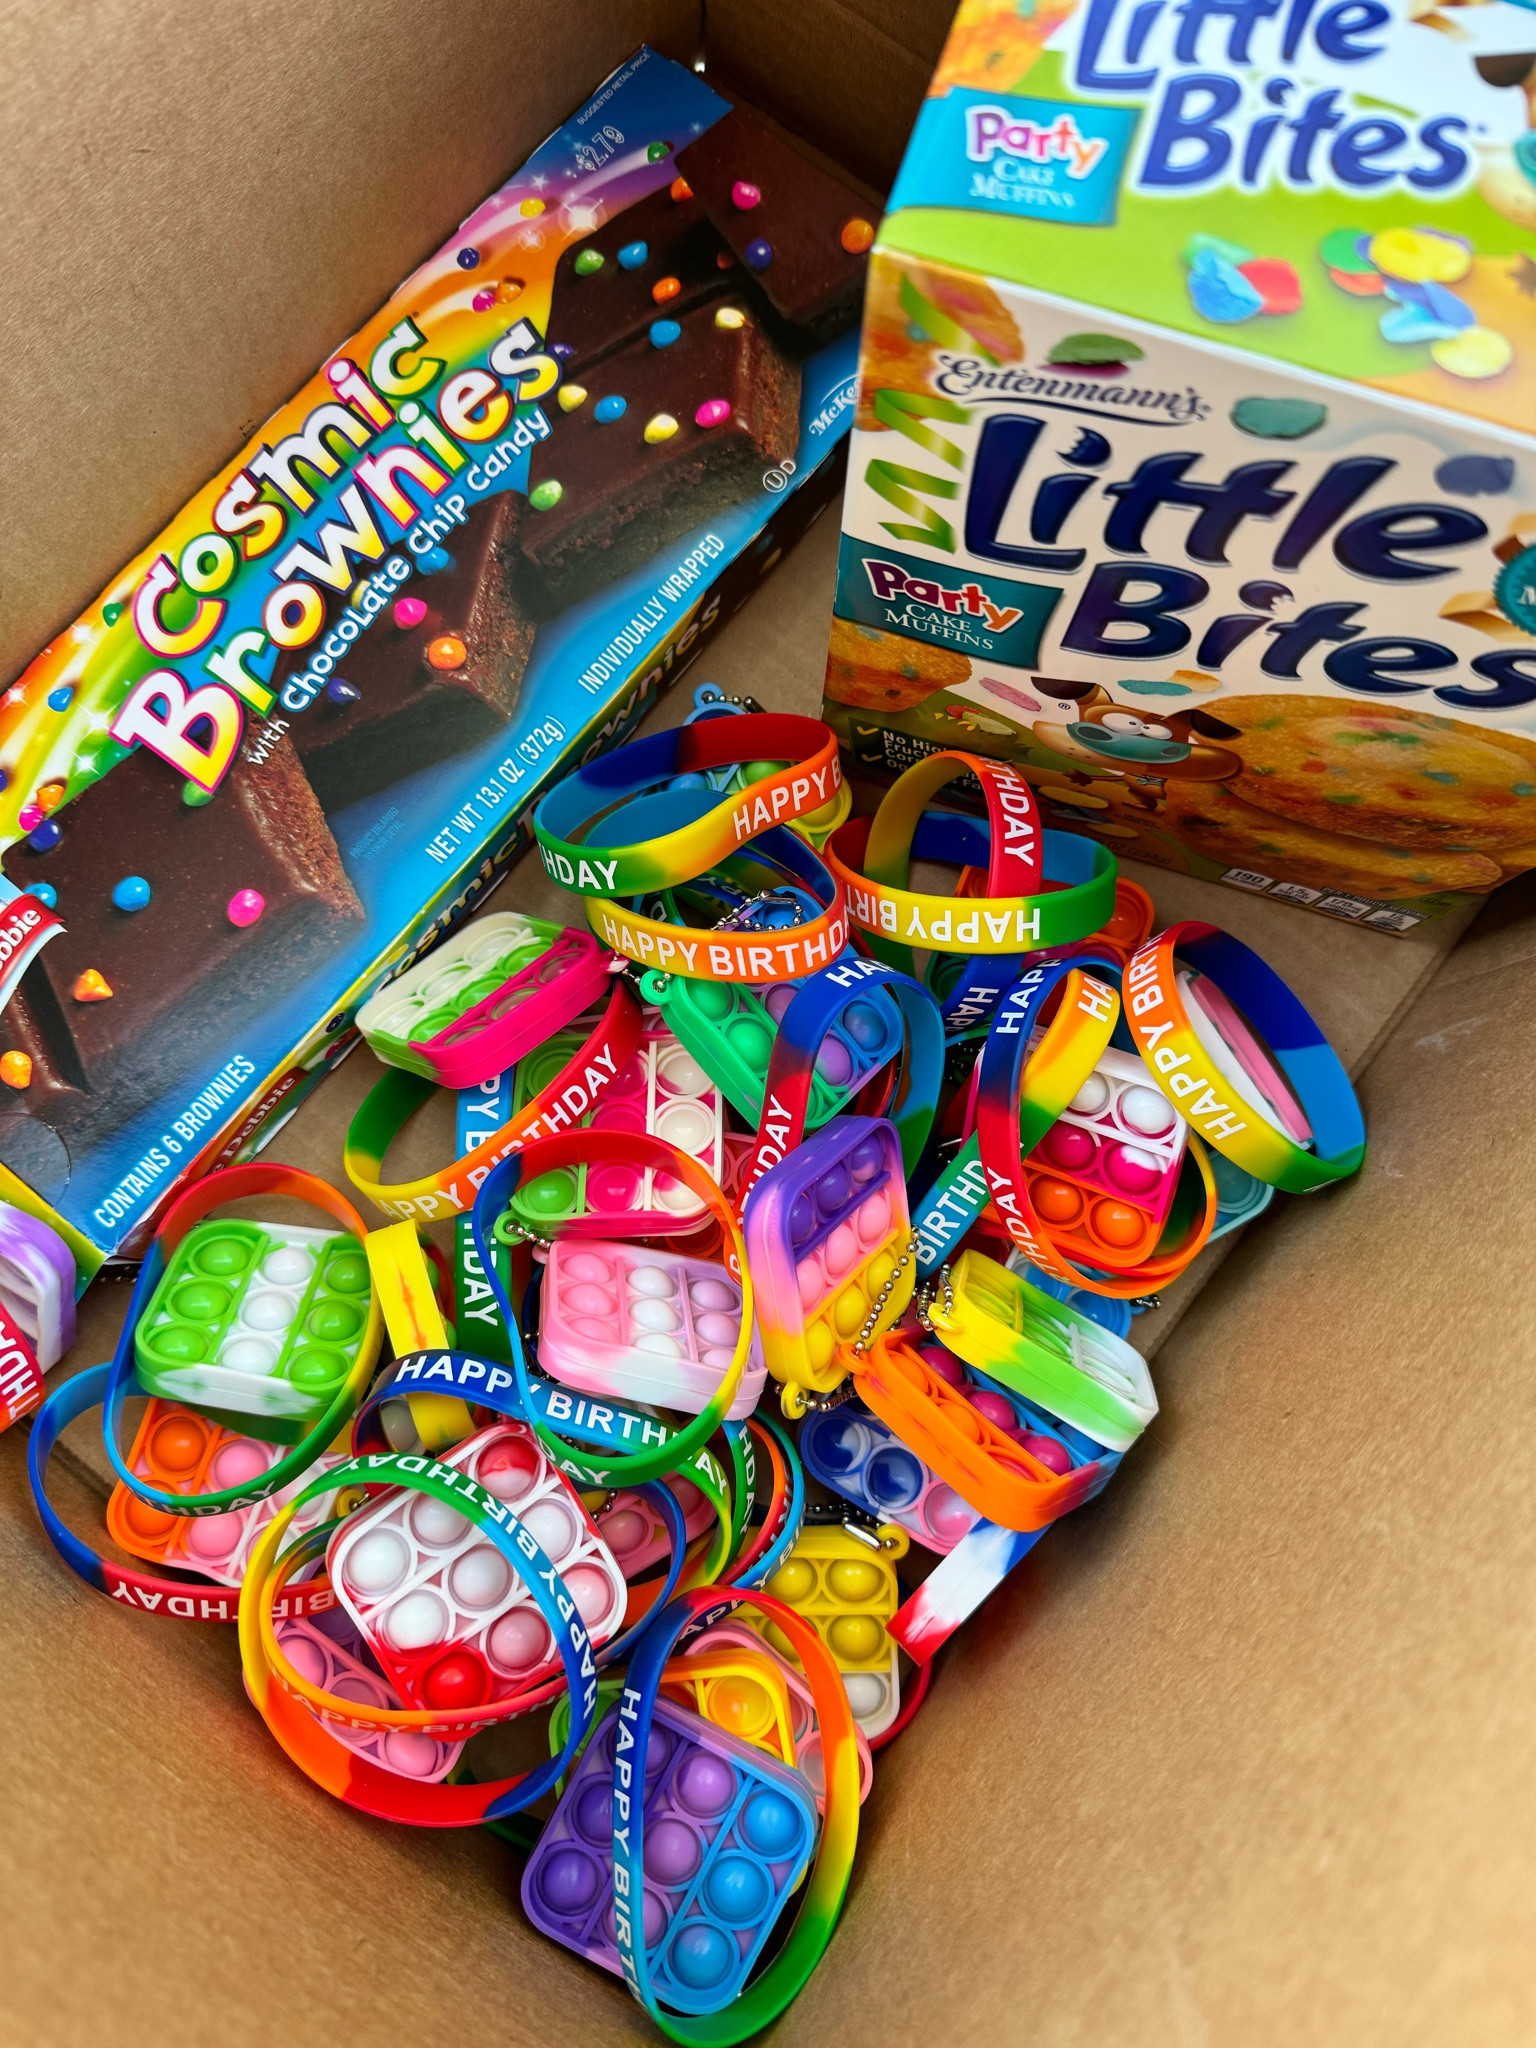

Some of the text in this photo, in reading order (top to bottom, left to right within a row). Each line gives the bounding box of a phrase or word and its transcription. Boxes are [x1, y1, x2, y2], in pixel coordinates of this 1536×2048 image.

[577, 52, 650, 125] SUGGESTED RETAIL PRICE
[1074, 0, 1393, 91] Little
[576, 126, 624, 171] $2.79
[968, 108, 1107, 177] Party
[1137, 73, 1470, 191] Bites
[133, 316, 446, 659] Cosmic
[964, 413, 1490, 577] Little
[108, 316, 564, 795] Brownies
[863, 557, 1024, 633] Party
[577, 533, 725, 695] INDIVIDUALLY WRAPPED
[1060, 562, 1536, 709] Bites
[247, 718, 290, 767] with
[883, 730, 906, 745] No
[884, 740, 931, 757] Fruct
[424, 715, 567, 865] NET WT 13.1 OZ (372g)
[733, 770, 828, 841] HAPPY
[0, 909, 42, 972] bbie
[602, 914, 698, 972] HAPPY
[906, 906, 1040, 944] HAPPY
[222, 1077, 296, 1158] Debbie
[1140, 1021, 1247, 1140] HAPPY
[94, 1054, 256, 1228] CONTAINS 6 BROWNIES
[333, 1453, 539, 1560] BIRTHDAY
[538, 1569, 599, 1720] HAPPY
[613, 1687, 641, 1857] HAPPY
